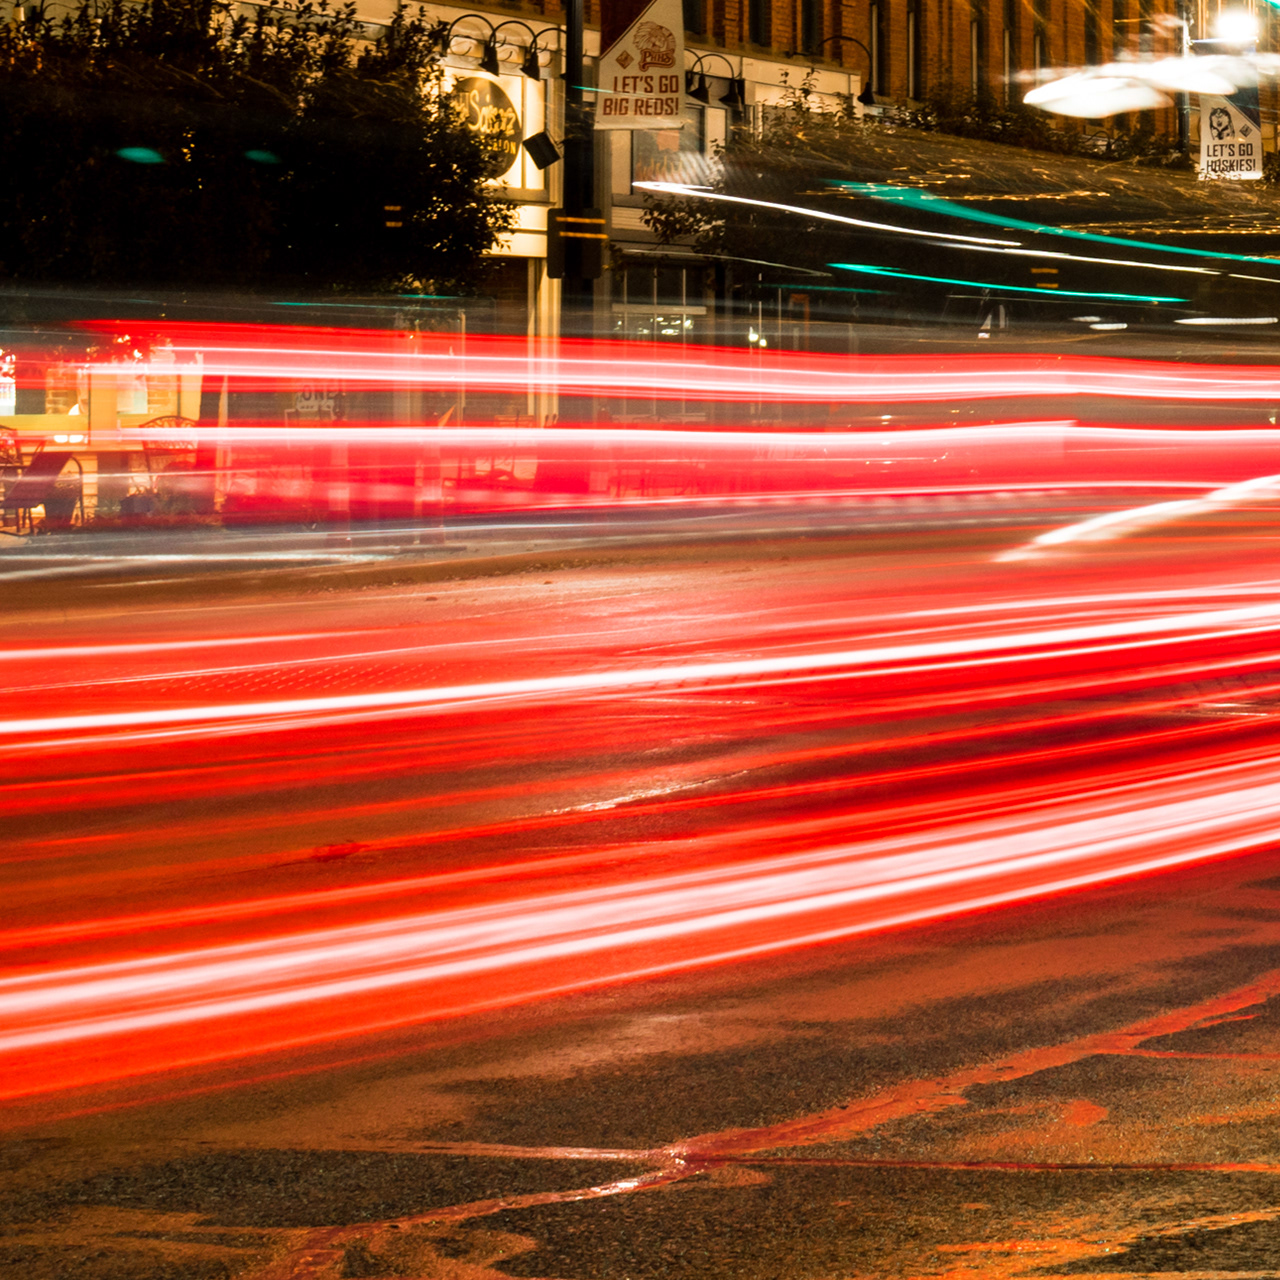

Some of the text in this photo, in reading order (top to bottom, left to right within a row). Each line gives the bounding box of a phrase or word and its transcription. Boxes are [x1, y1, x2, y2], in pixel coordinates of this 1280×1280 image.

[613, 75, 679, 93] LET'S GO
[603, 97, 679, 115] BIG REDS!
[1207, 143, 1253, 157] LET'S GO
[1207, 159, 1256, 172] HUSKIES!
